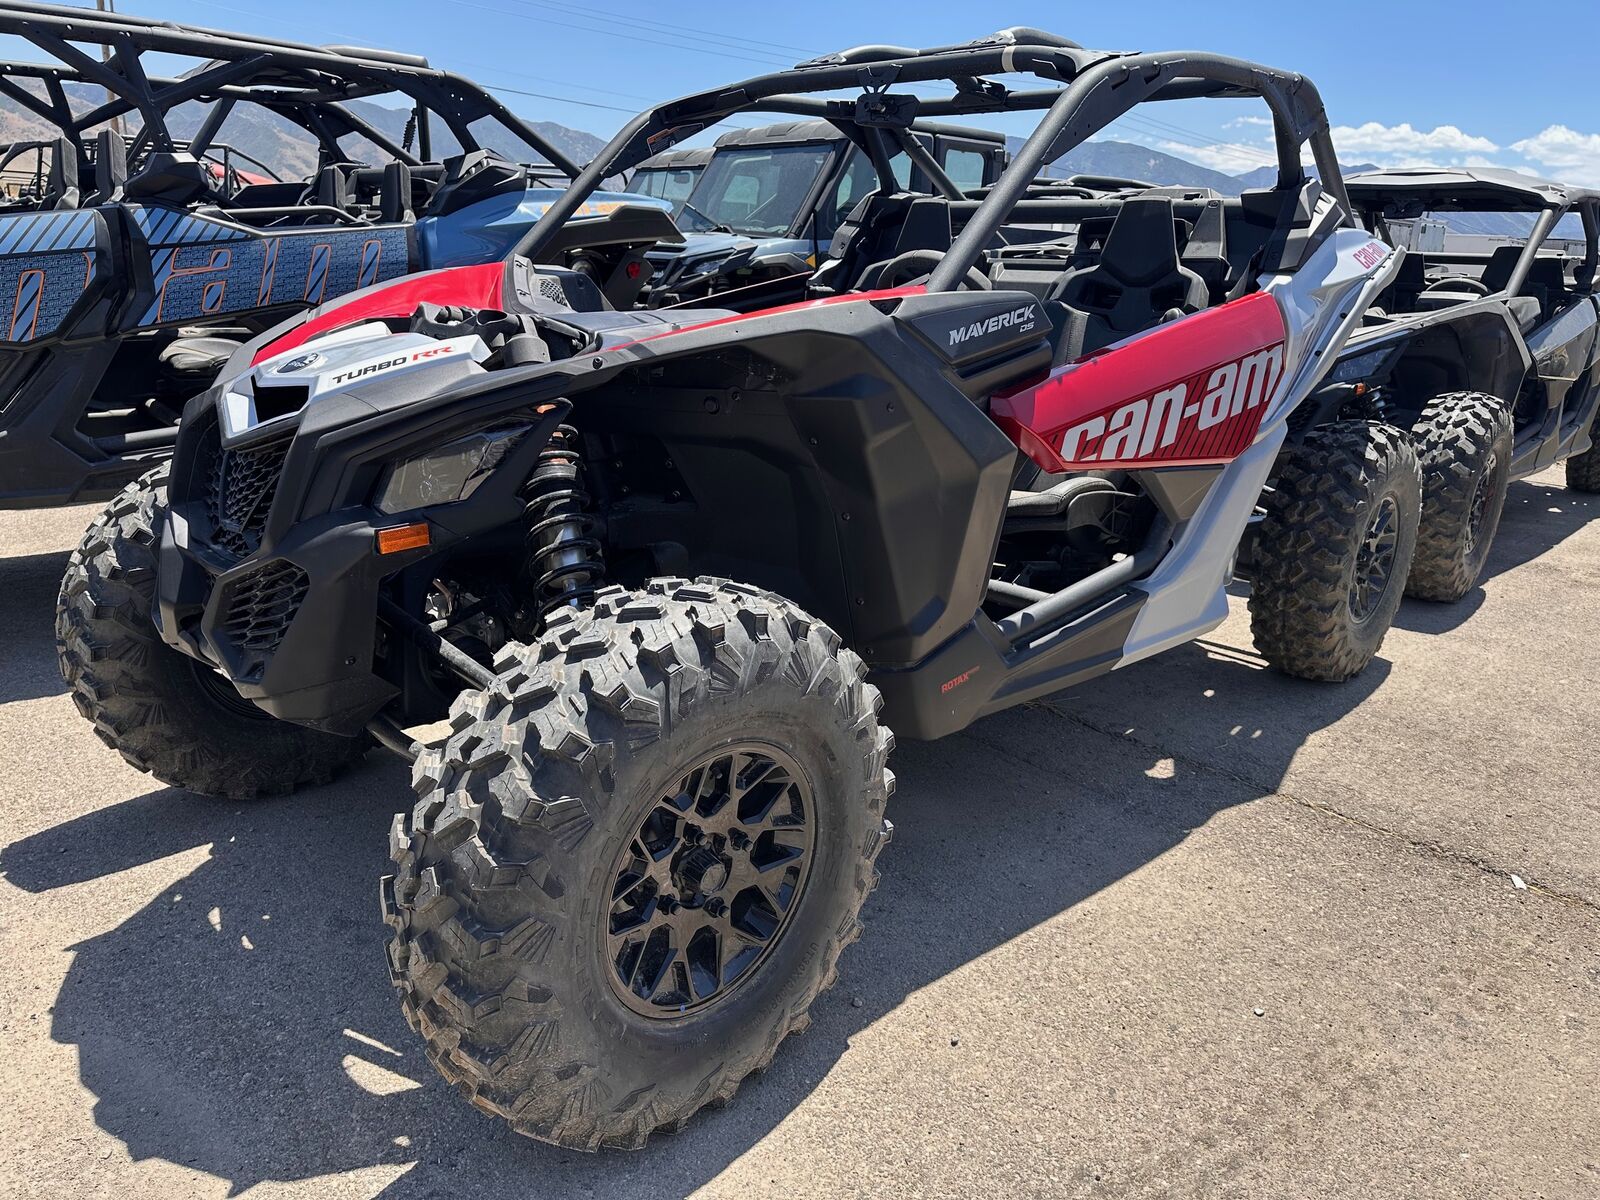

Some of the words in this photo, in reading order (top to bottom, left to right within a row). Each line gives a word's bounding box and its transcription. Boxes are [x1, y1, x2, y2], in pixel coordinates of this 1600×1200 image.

[1353, 242, 1387, 270] can-am
[949, 304, 1036, 346] MAVERICK
[1020, 321, 1035, 333] DS
[332, 356, 407, 384] TURBO
[413, 346, 455, 361] RR
[1060, 344, 1284, 462] can-am
[941, 671, 969, 695] ROTAX
